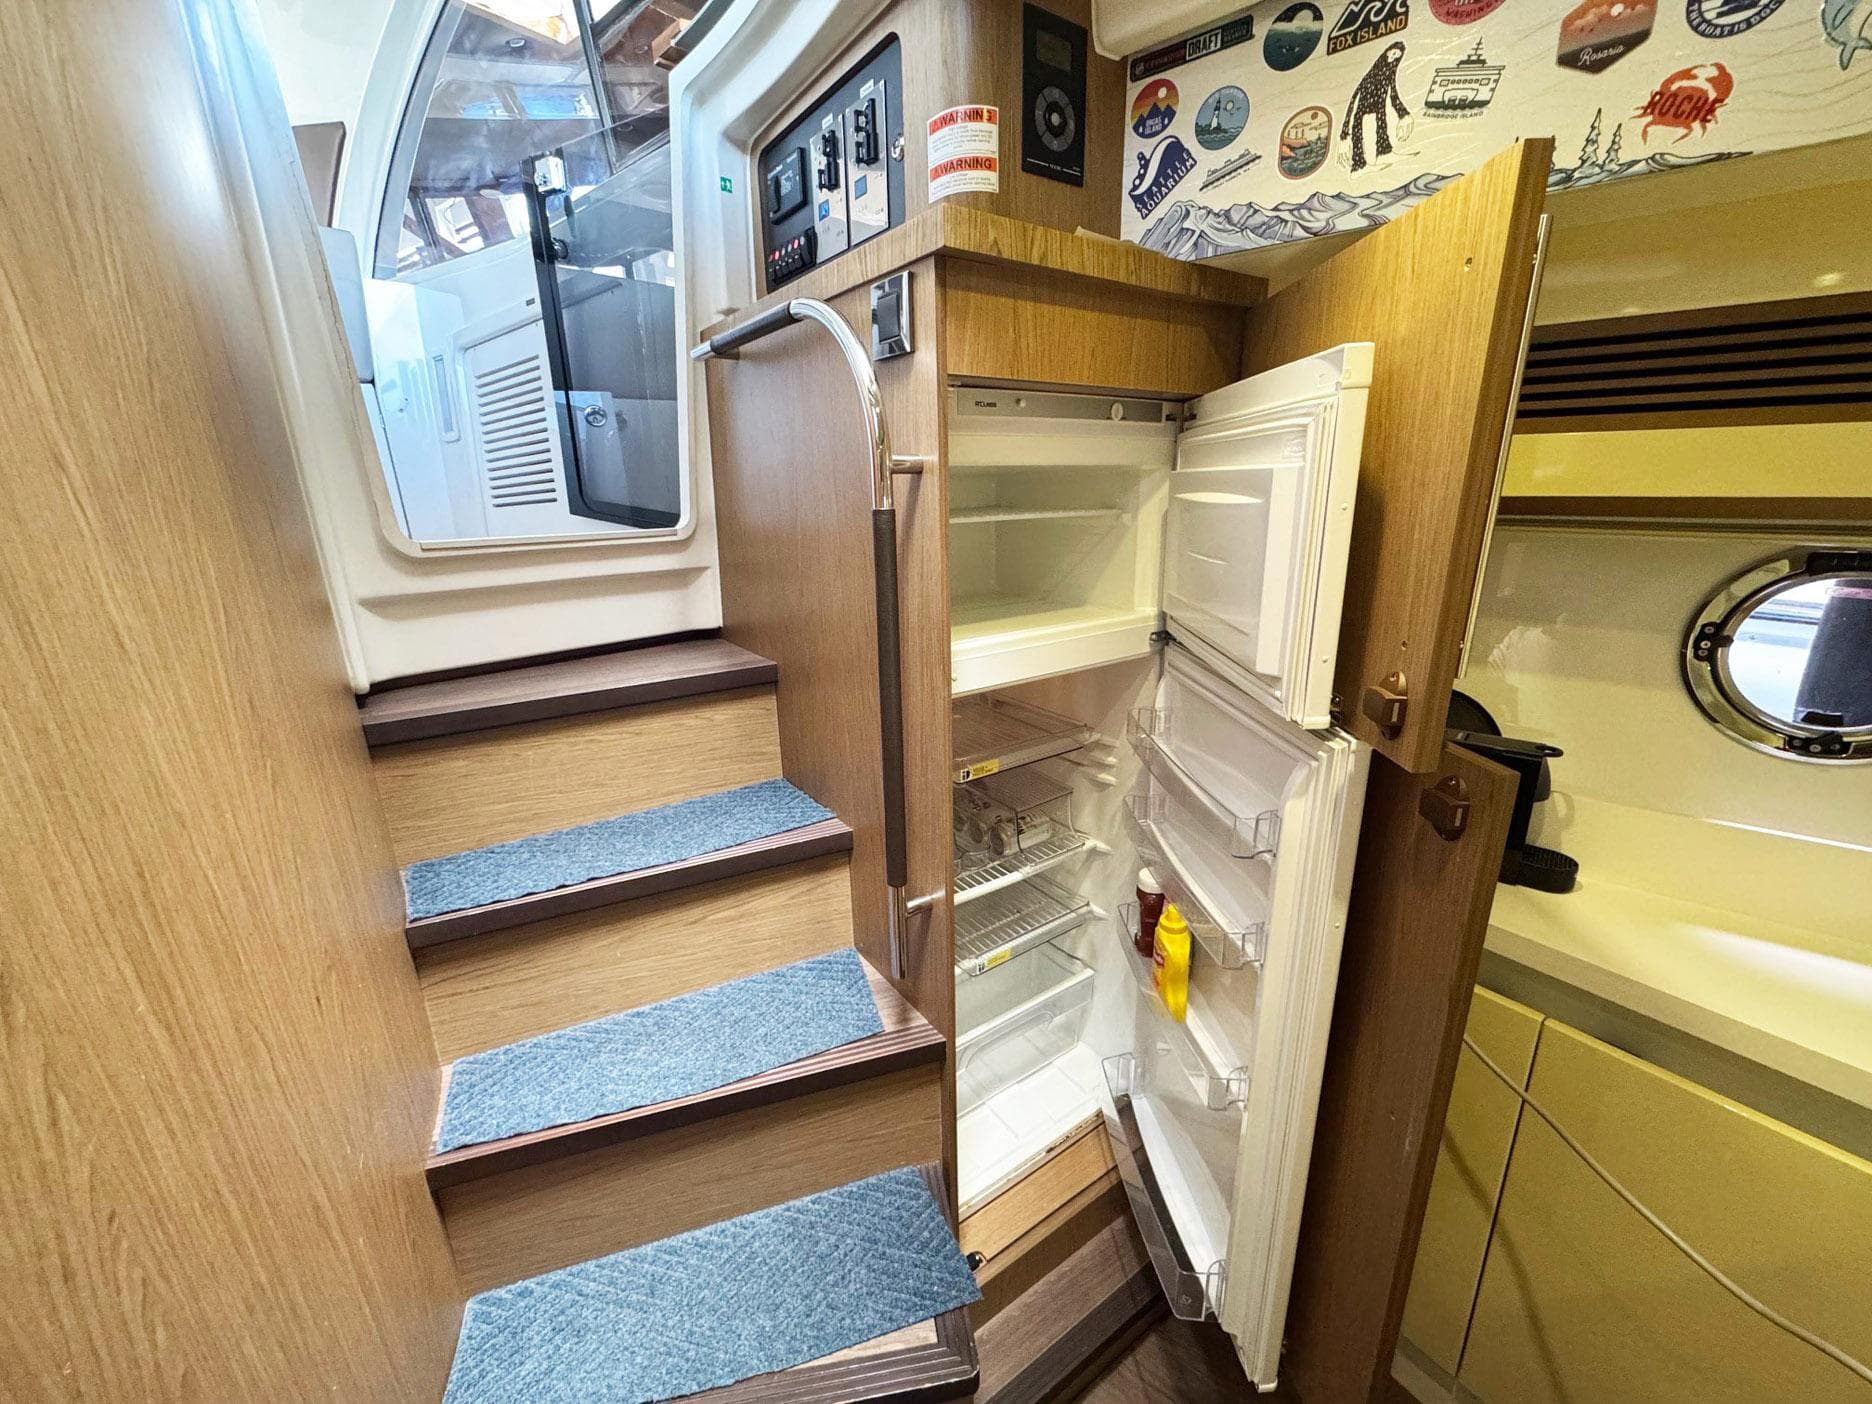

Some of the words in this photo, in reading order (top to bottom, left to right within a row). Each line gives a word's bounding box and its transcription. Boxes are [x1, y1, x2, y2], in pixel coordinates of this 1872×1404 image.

[1329, 33, 1354, 53] FOX
[1356, 15, 1406, 43] ISLAND
[1688, 2, 1703, 27] THE
[1698, 22, 1731, 37] BOAT
[1733, 20, 1747, 33] IS
[1750, 0, 1780, 25] DOC
[1188, 33, 1220, 58] DRAFT
[1578, 45, 1624, 66] Rosario
[940, 159, 992, 174] WARNING
[1136, 151, 1191, 210] SEATTLE
[1141, 157, 1196, 218] AQUARIUM
